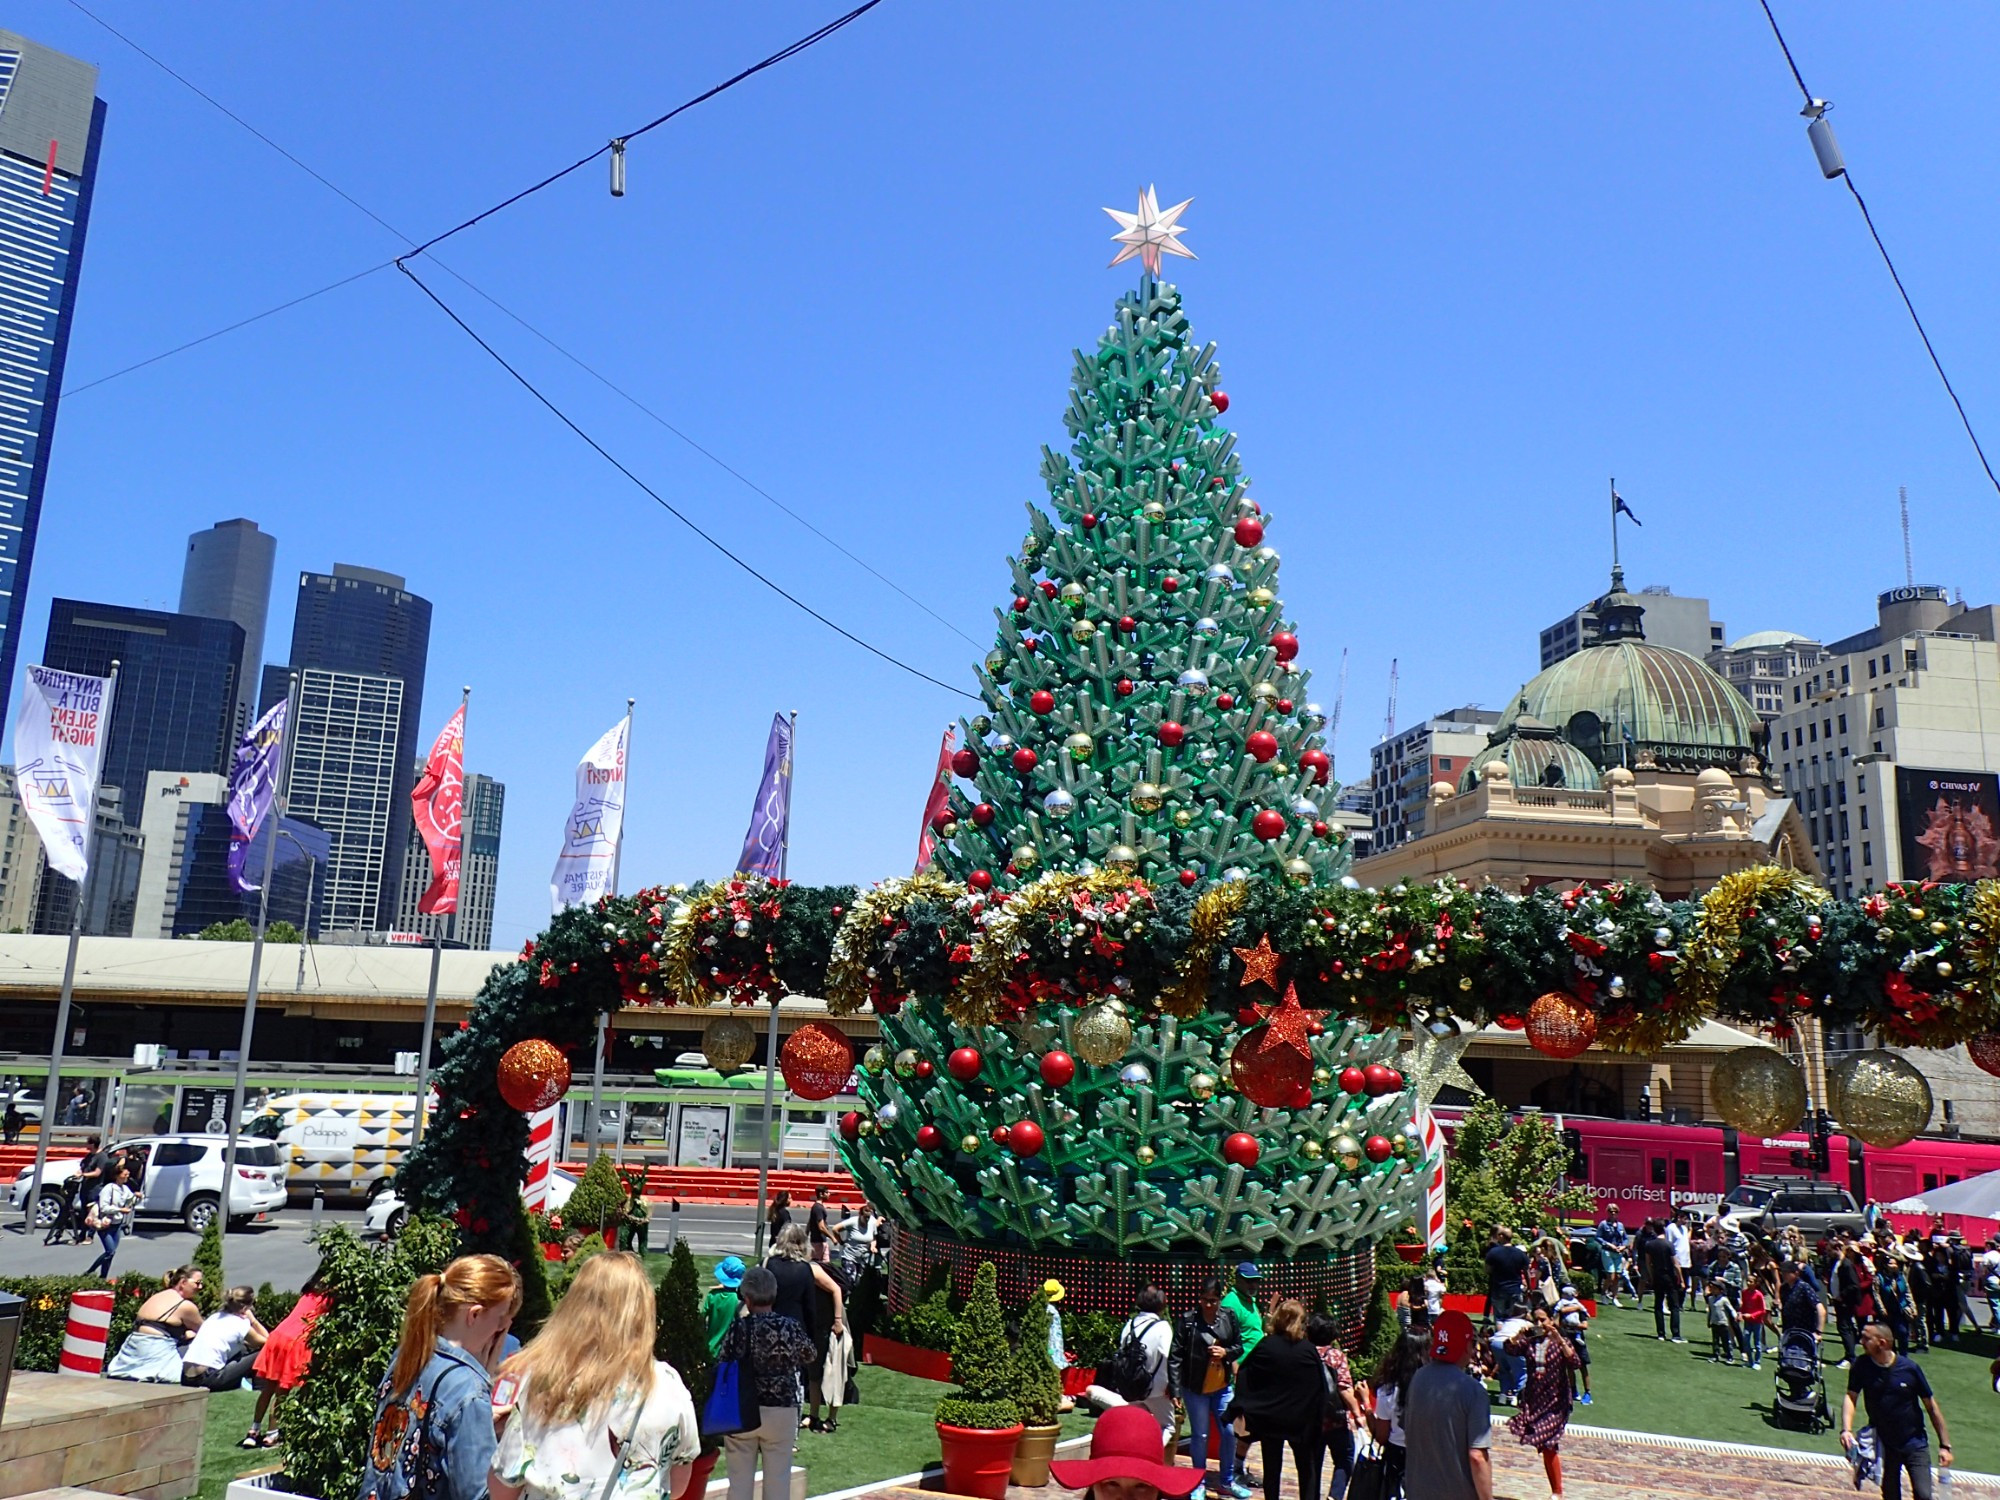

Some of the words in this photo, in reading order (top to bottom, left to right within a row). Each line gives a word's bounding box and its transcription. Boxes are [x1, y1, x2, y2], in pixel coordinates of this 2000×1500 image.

[1940, 782, 1968, 790] CHIVAS
[1621, 1184, 1667, 1202] offset
[1670, 1190, 1726, 1206] power
